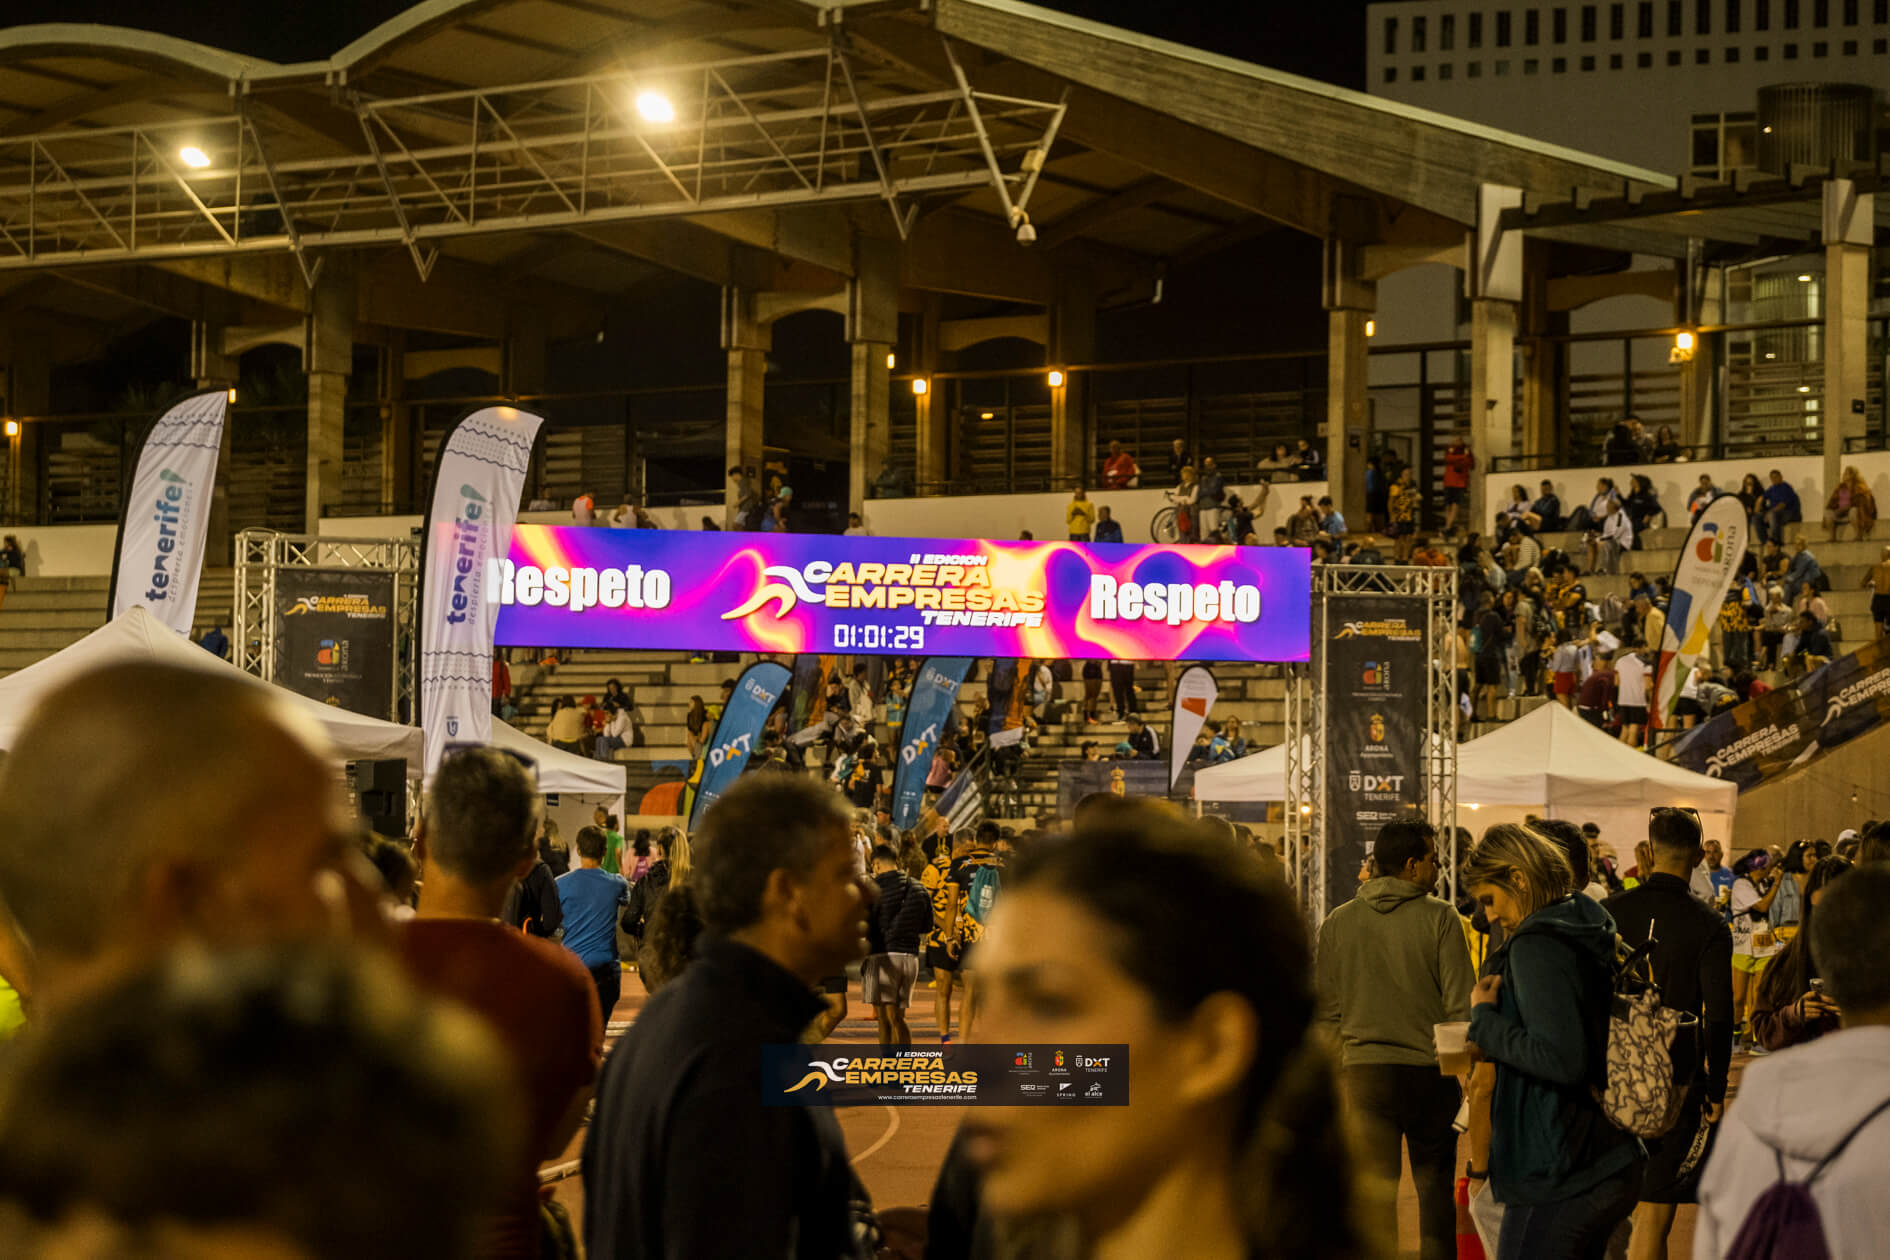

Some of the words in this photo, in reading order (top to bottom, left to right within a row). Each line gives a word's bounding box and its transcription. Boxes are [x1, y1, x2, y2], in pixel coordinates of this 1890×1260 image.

[803, 560, 991, 587] CARRERA
[923, 554, 988, 566] EDICION
[487, 557, 671, 611] Respeto
[825, 584, 1046, 612] EMPRESAS
[1090, 573, 1261, 626] Respeto
[921, 610, 1044, 627] TENERIFE
[834, 624, 925, 649] 01:01:29
[752, 684, 776, 704] DXT
[934, 673, 958, 692] DXT
[709, 732, 752, 768] DXT
[901, 722, 937, 766] DXT
[1716, 723, 1778, 759] CARRERA
[1726, 724, 1800, 766] EMPRESAS
[1363, 775, 1404, 791] DXT
[1363, 792, 1401, 801] TENERIFE
